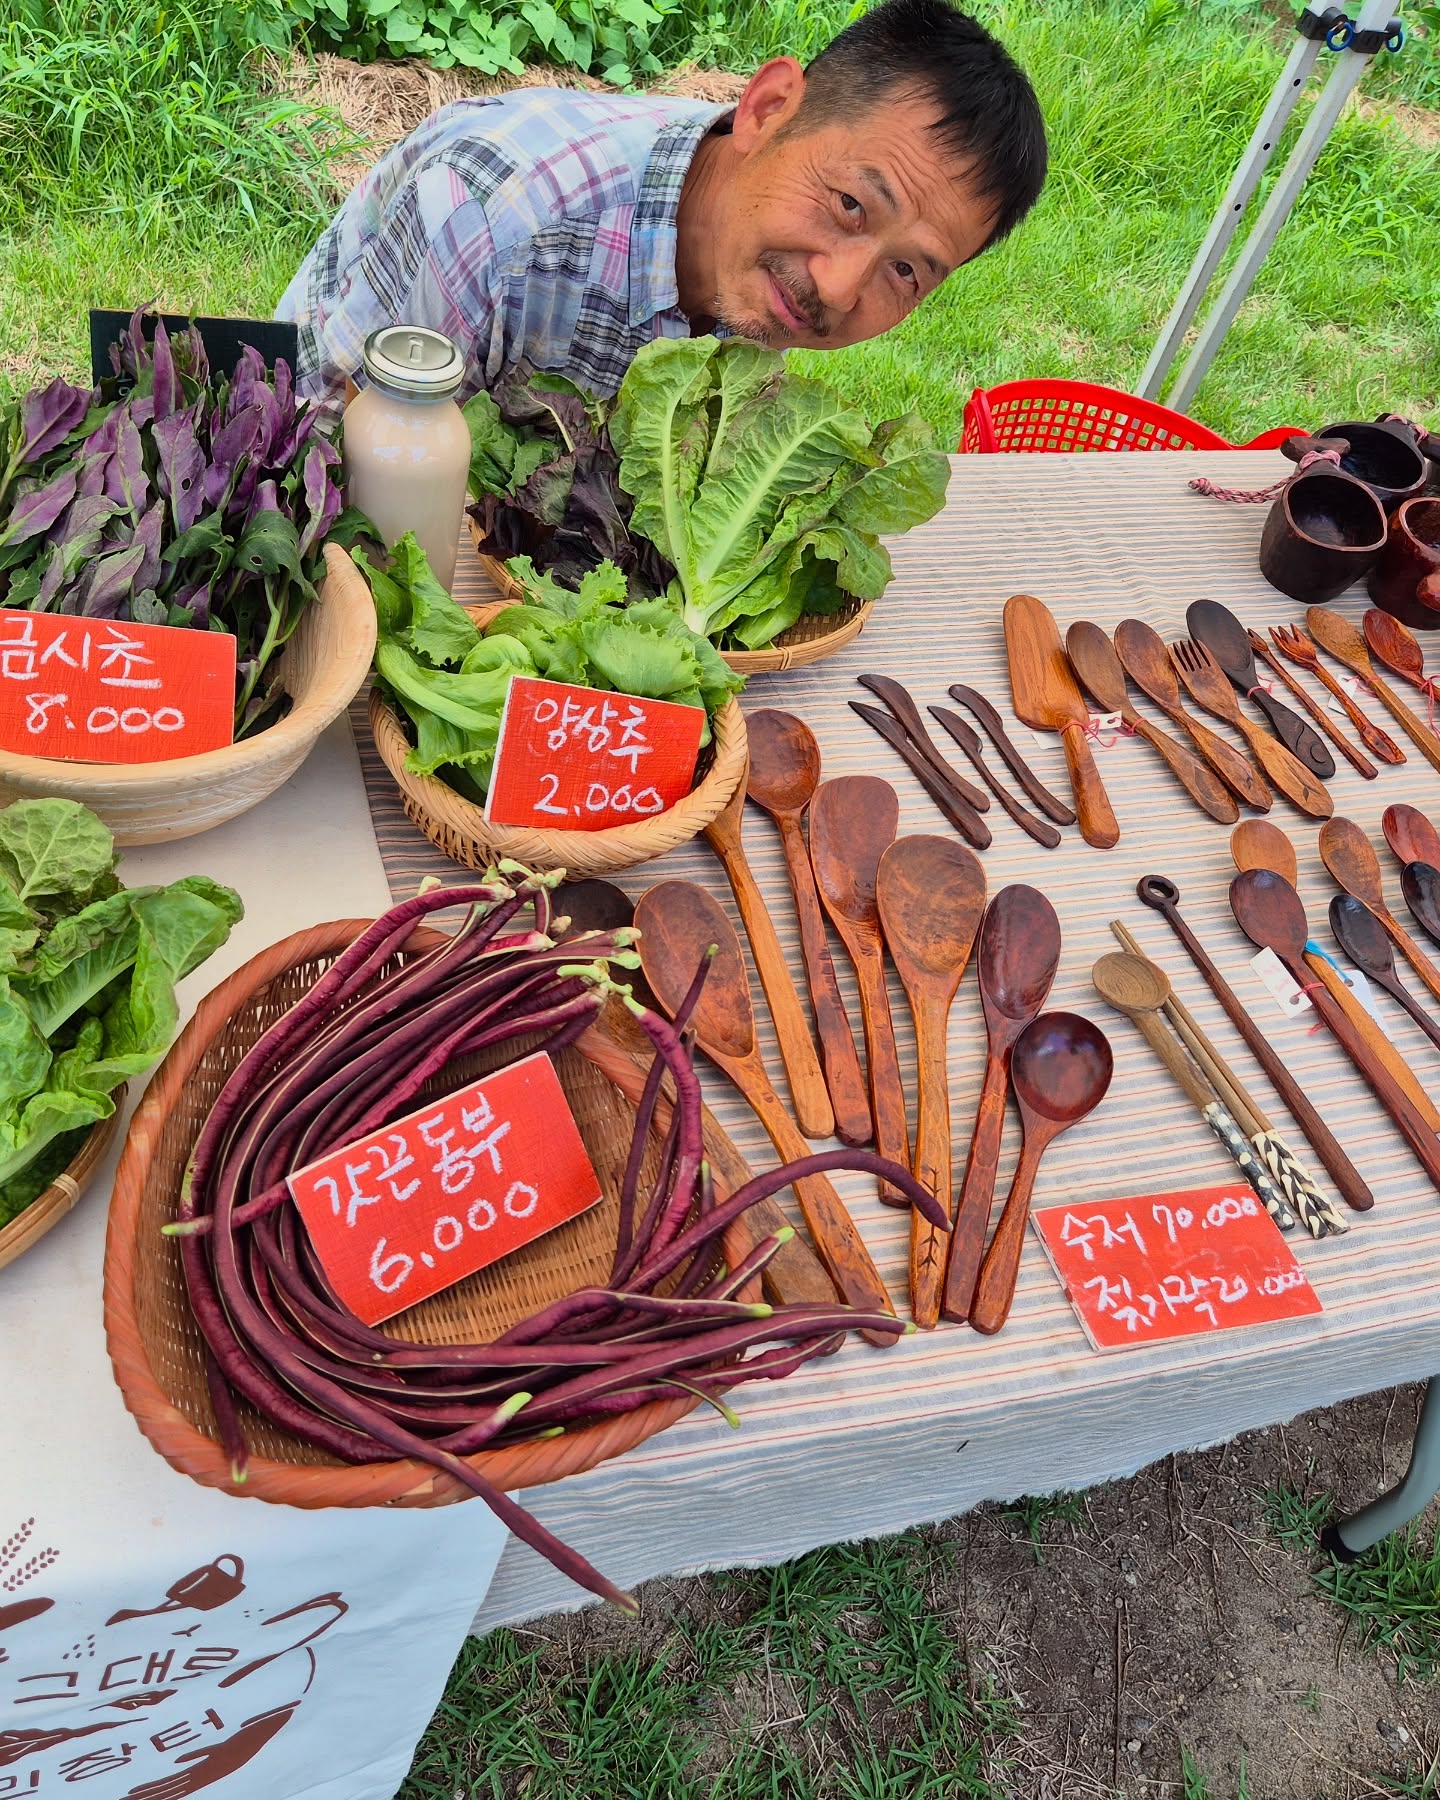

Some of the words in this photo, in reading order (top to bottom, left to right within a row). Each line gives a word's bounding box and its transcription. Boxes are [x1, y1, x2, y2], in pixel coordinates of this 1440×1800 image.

[0, 616, 163, 690] 금시초
[533, 695, 654, 775] 양상추
[312, 1090, 512, 1229] 갓끈동부
[1060, 1210, 1147, 1262] 수저
